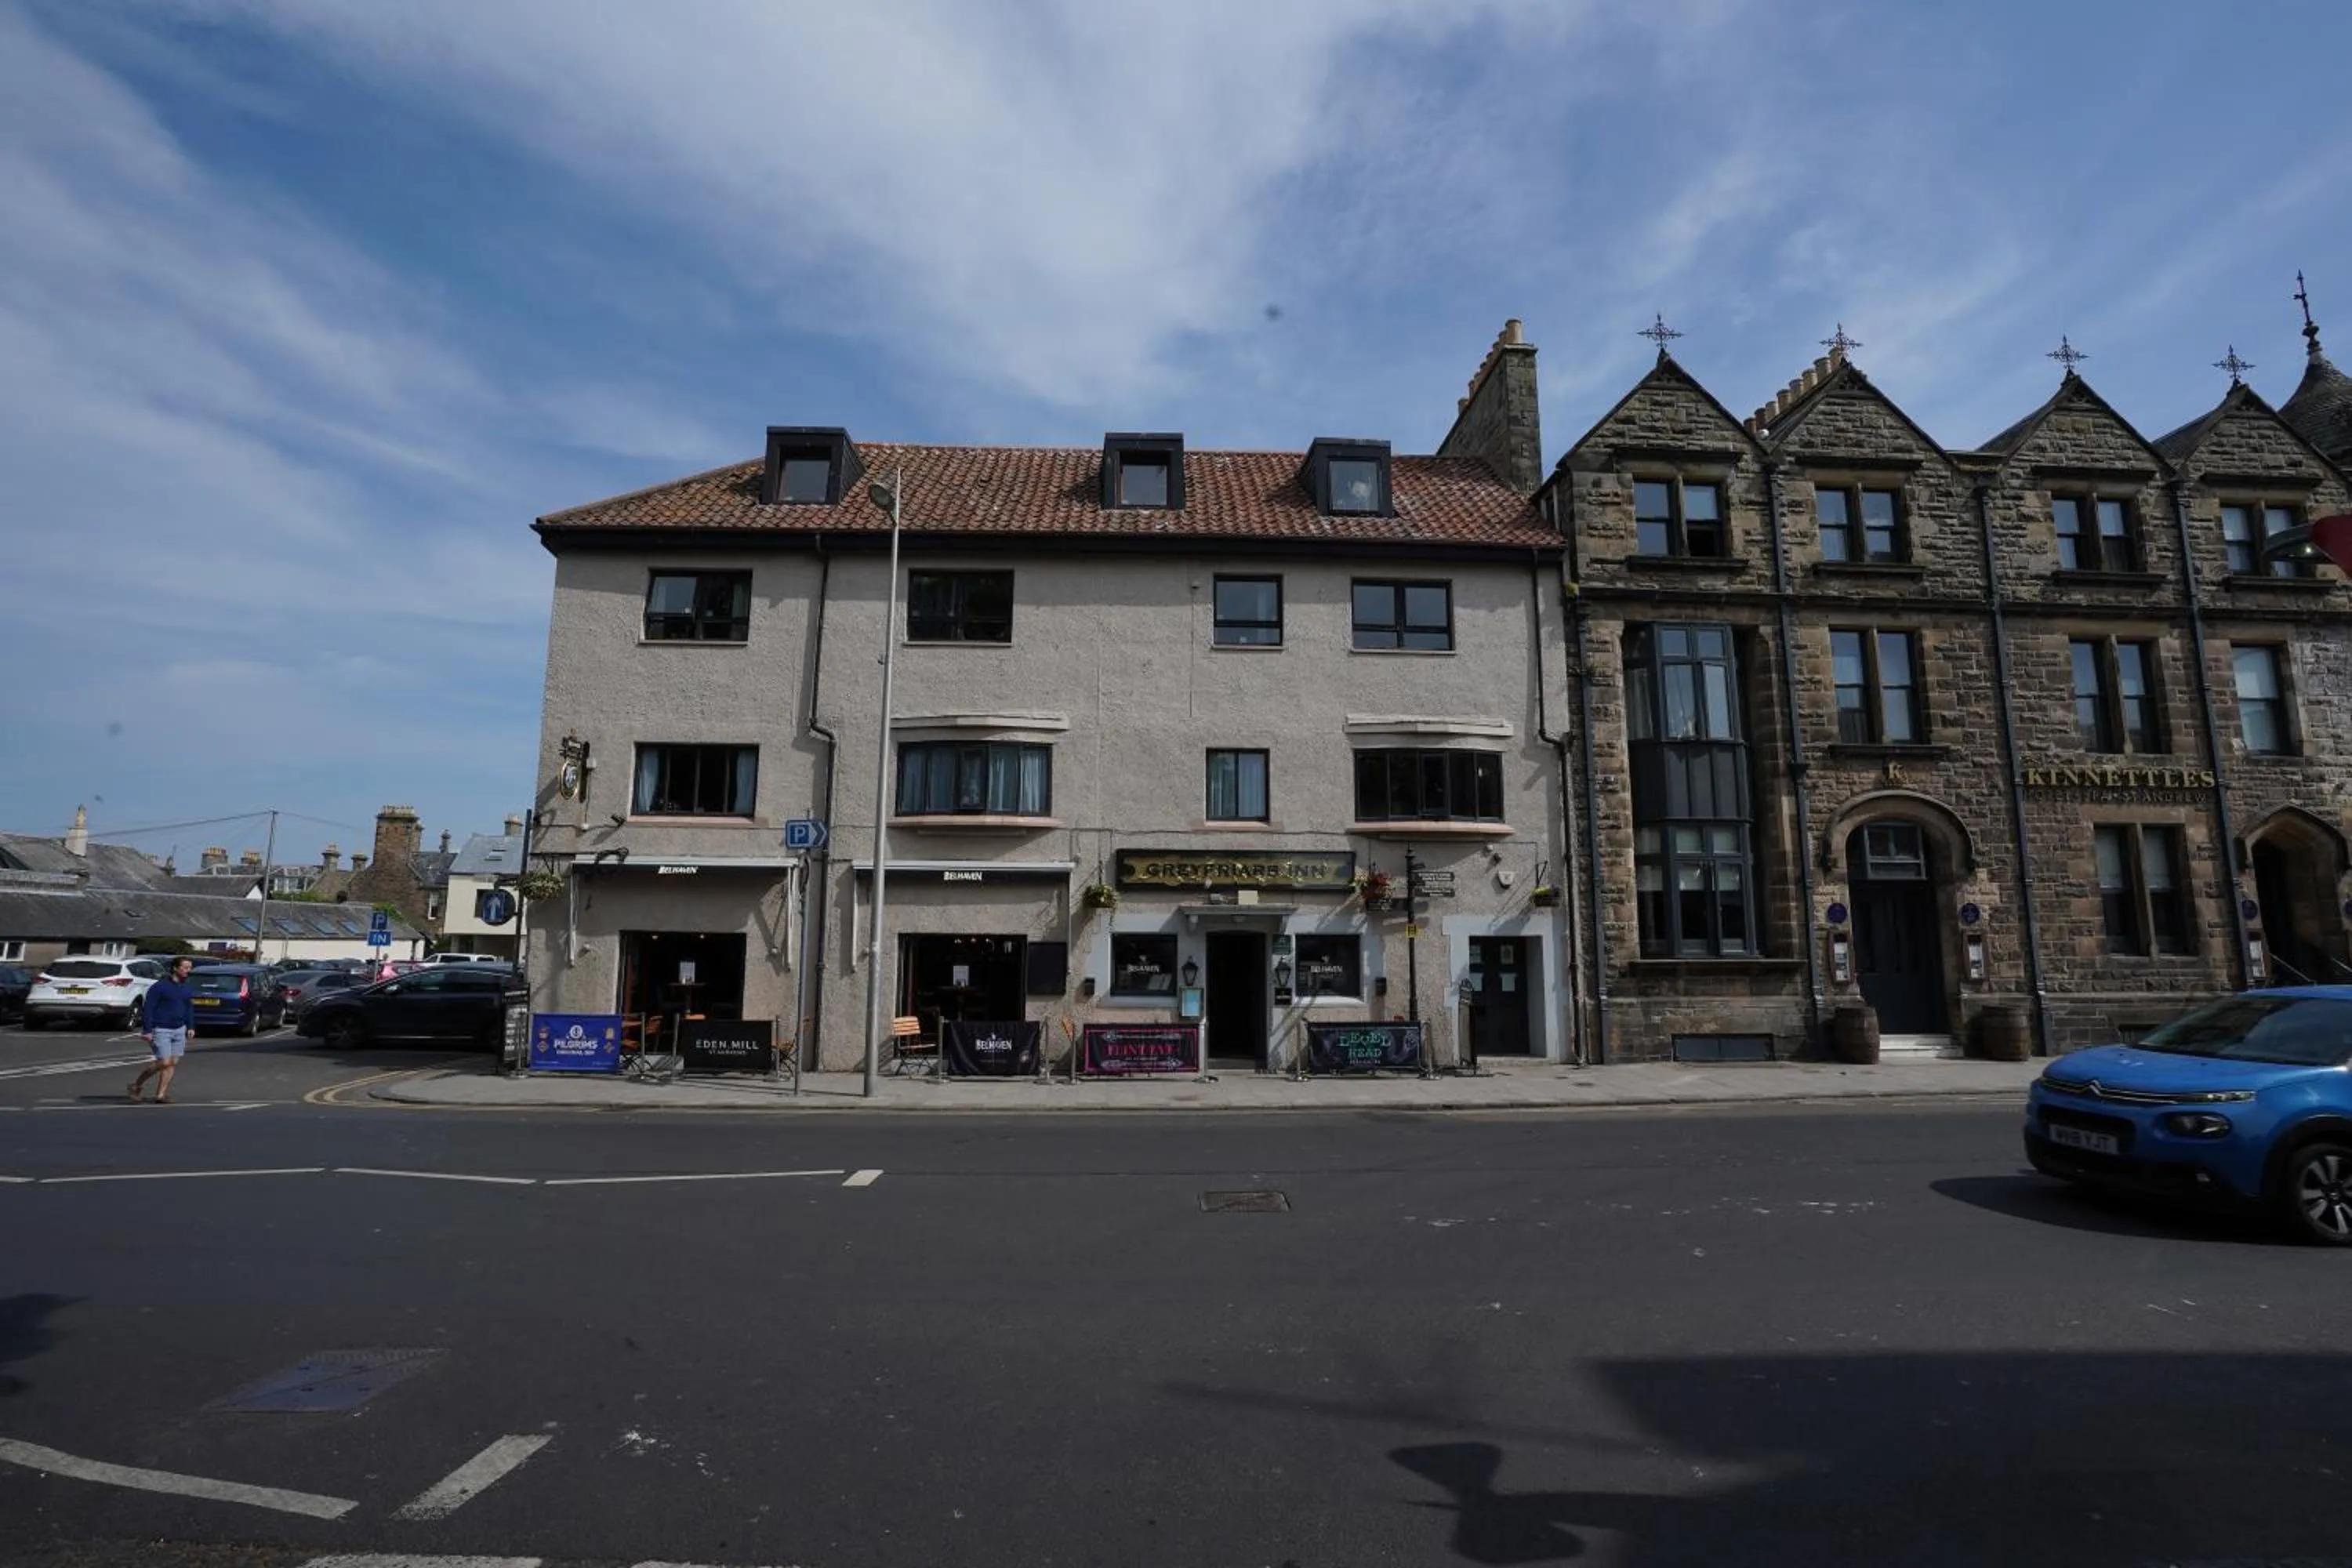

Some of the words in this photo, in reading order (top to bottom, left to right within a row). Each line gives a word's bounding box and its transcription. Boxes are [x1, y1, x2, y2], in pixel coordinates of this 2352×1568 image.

[2027, 767, 2216, 788] KINNETTLES
[794, 826, 806, 843] P
[658, 866, 698, 874] BELHAVEN
[1146, 862, 1279, 879] GREYFRIARS
[1287, 862, 1326, 879] INN
[943, 871, 983, 881] BELHAVEN
[376, 915, 386, 929] P
[372, 934, 387, 944] IN
[554, 1039, 598, 1050] PILGRIMS
[695, 1040, 727, 1049] EDEN
[731, 1040, 759, 1050] MILL
[975, 1039, 1012, 1051] BELHAVEN
[1348, 1048, 1382, 1058] HEAD
